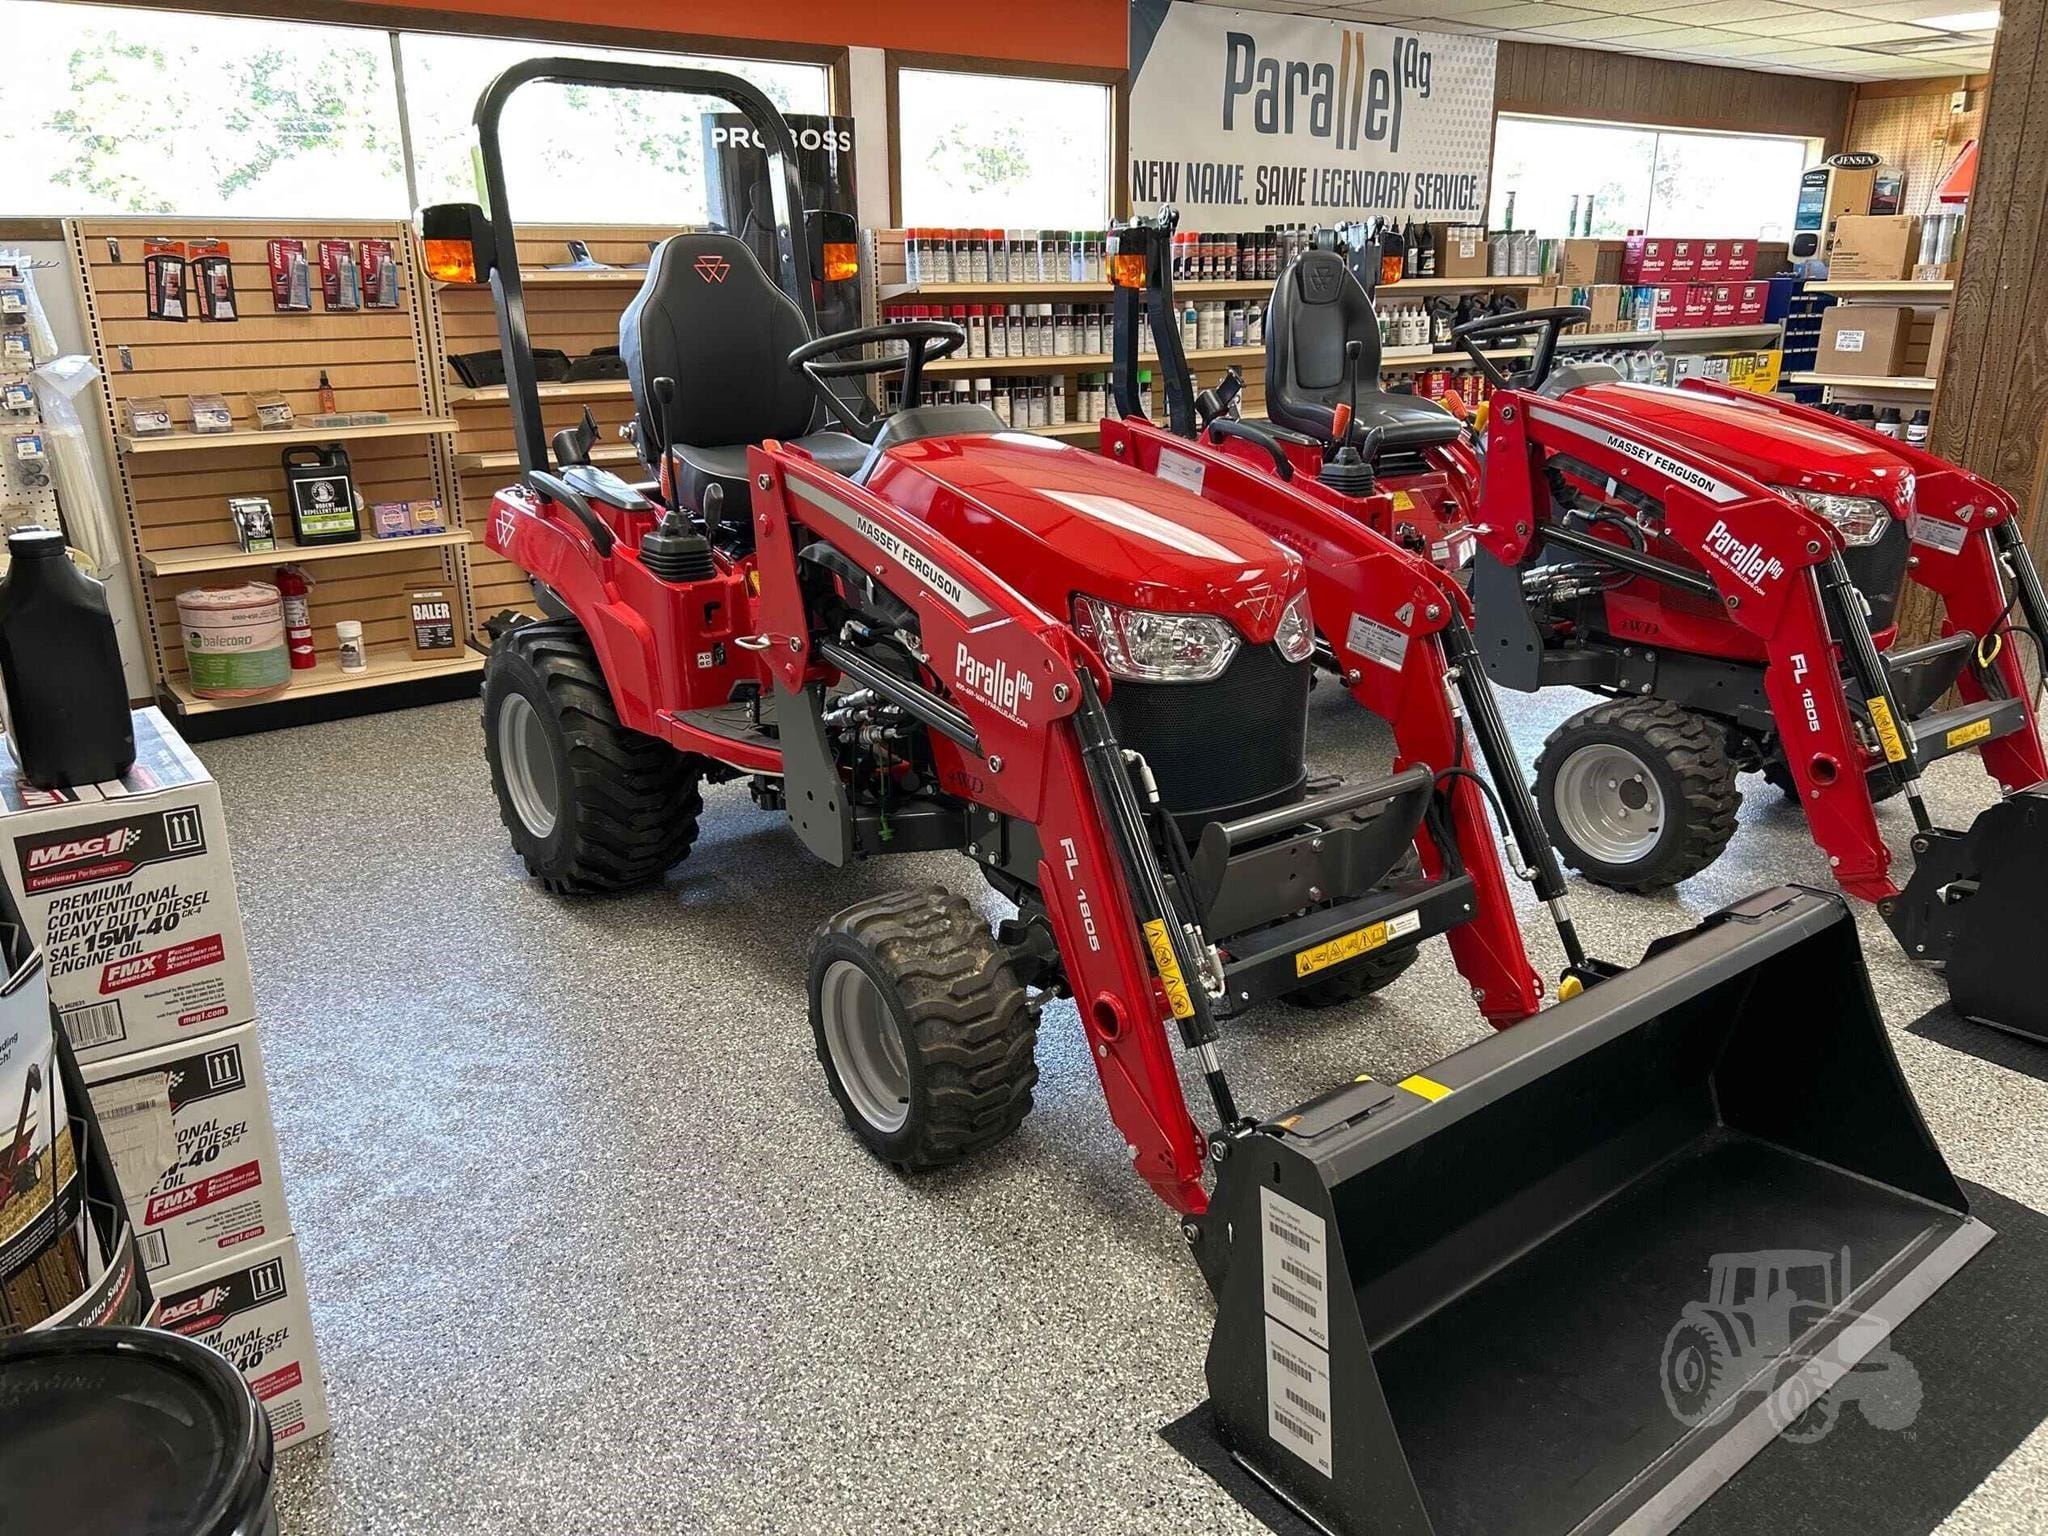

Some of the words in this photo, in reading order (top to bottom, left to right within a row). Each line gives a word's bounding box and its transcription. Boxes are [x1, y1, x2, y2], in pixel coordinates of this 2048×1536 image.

[1223, 30, 1403, 153] Parallel
[1837, 155, 1876, 166] JENSEN
[1132, 160, 1180, 203] NEW
[1186, 162, 1248, 205] NAME.
[1256, 165, 1307, 206] SAME
[1311, 167, 1411, 209] LEGENDARY
[1413, 173, 1480, 211] SERVICE.
[274, 242, 283, 269] LOCTITE
[321, 243, 331, 270] LOCTITE
[362, 243, 371, 270] LOCTITE
[1607, 435, 1653, 462] MASSEY
[1654, 456, 1716, 493] FERGUSON
[857, 517, 900, 560] MASSEY
[902, 548, 961, 603] FERGUSON
[1705, 520, 1775, 585] Parallel
[412, 603, 450, 621] BALER
[955, 642, 1020, 715] Parallel
[1790, 653, 1808, 684] FL
[1802, 688, 1821, 732] 1805
[29, 829, 125, 867] MAG1
[32, 872, 77, 887] Evolutionary
[1059, 838, 1079, 880] FL
[1077, 888, 1101, 952] 1805
[48, 881, 133, 915] PREMIUM
[48, 884, 179, 931] CONVENTIONAL
[46, 918, 105, 946] HEAVY
[107, 906, 153, 930] DUTY
[156, 890, 210, 917] DIESEL
[49, 942, 80, 963] SAE
[84, 912, 181, 953] 15W-40
[181, 906, 202, 918] CK-4
[50, 948, 117, 978] ENGINE
[119, 940, 144, 959] OIL
[107, 970, 157, 988] TECHNOLOGY
[183, 1008, 226, 1024] mag1.com
[198, 1120, 248, 1149] DIESEL
[221, 1136, 240, 1148] CK-4
[163, 1173, 186, 1191] OIL
[222, 1228, 262, 1246] mag1.com
[160, 1287, 216, 1322] AG1
[242, 1327, 290, 1358] DIESEL
[265, 1342, 283, 1355] CK-4
[1308, 1326, 1325, 1341] AGCO
